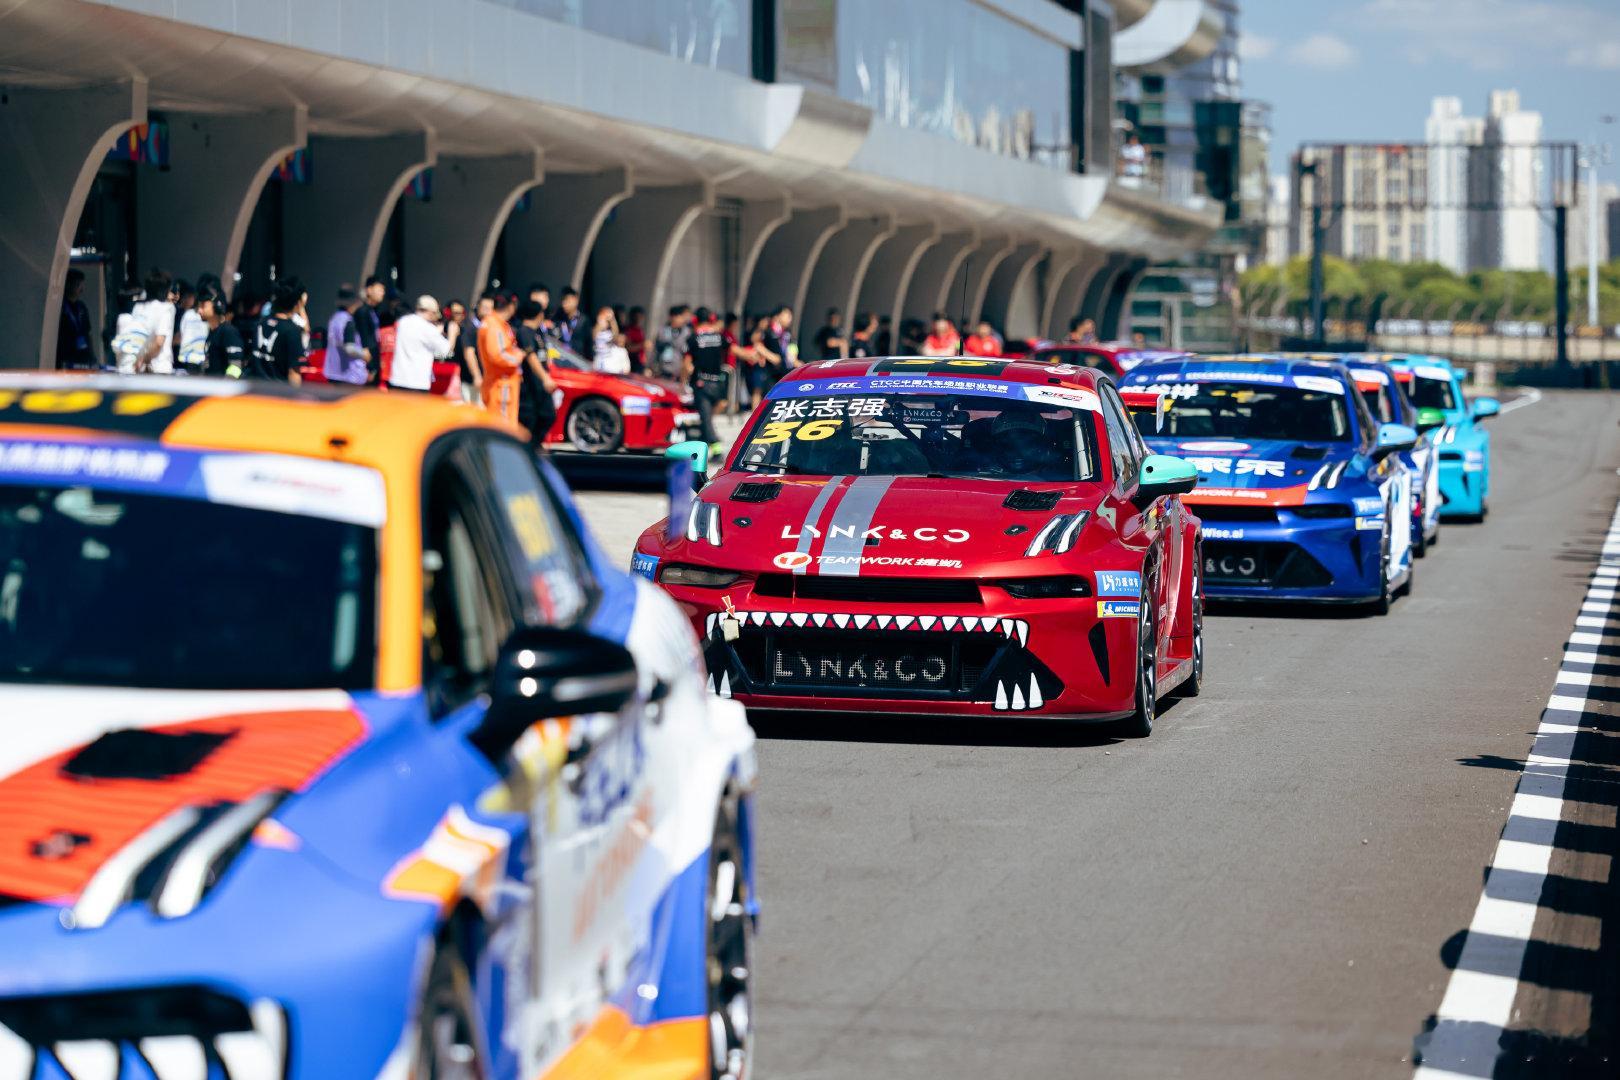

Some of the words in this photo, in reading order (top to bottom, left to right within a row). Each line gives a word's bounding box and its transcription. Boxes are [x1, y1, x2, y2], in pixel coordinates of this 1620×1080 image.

[771, 397, 885, 421] 张志强
[751, 419, 844, 444] 36
[815, 555, 916, 566] TEAMWORK
[1114, 605, 1139, 613] MICHEL
